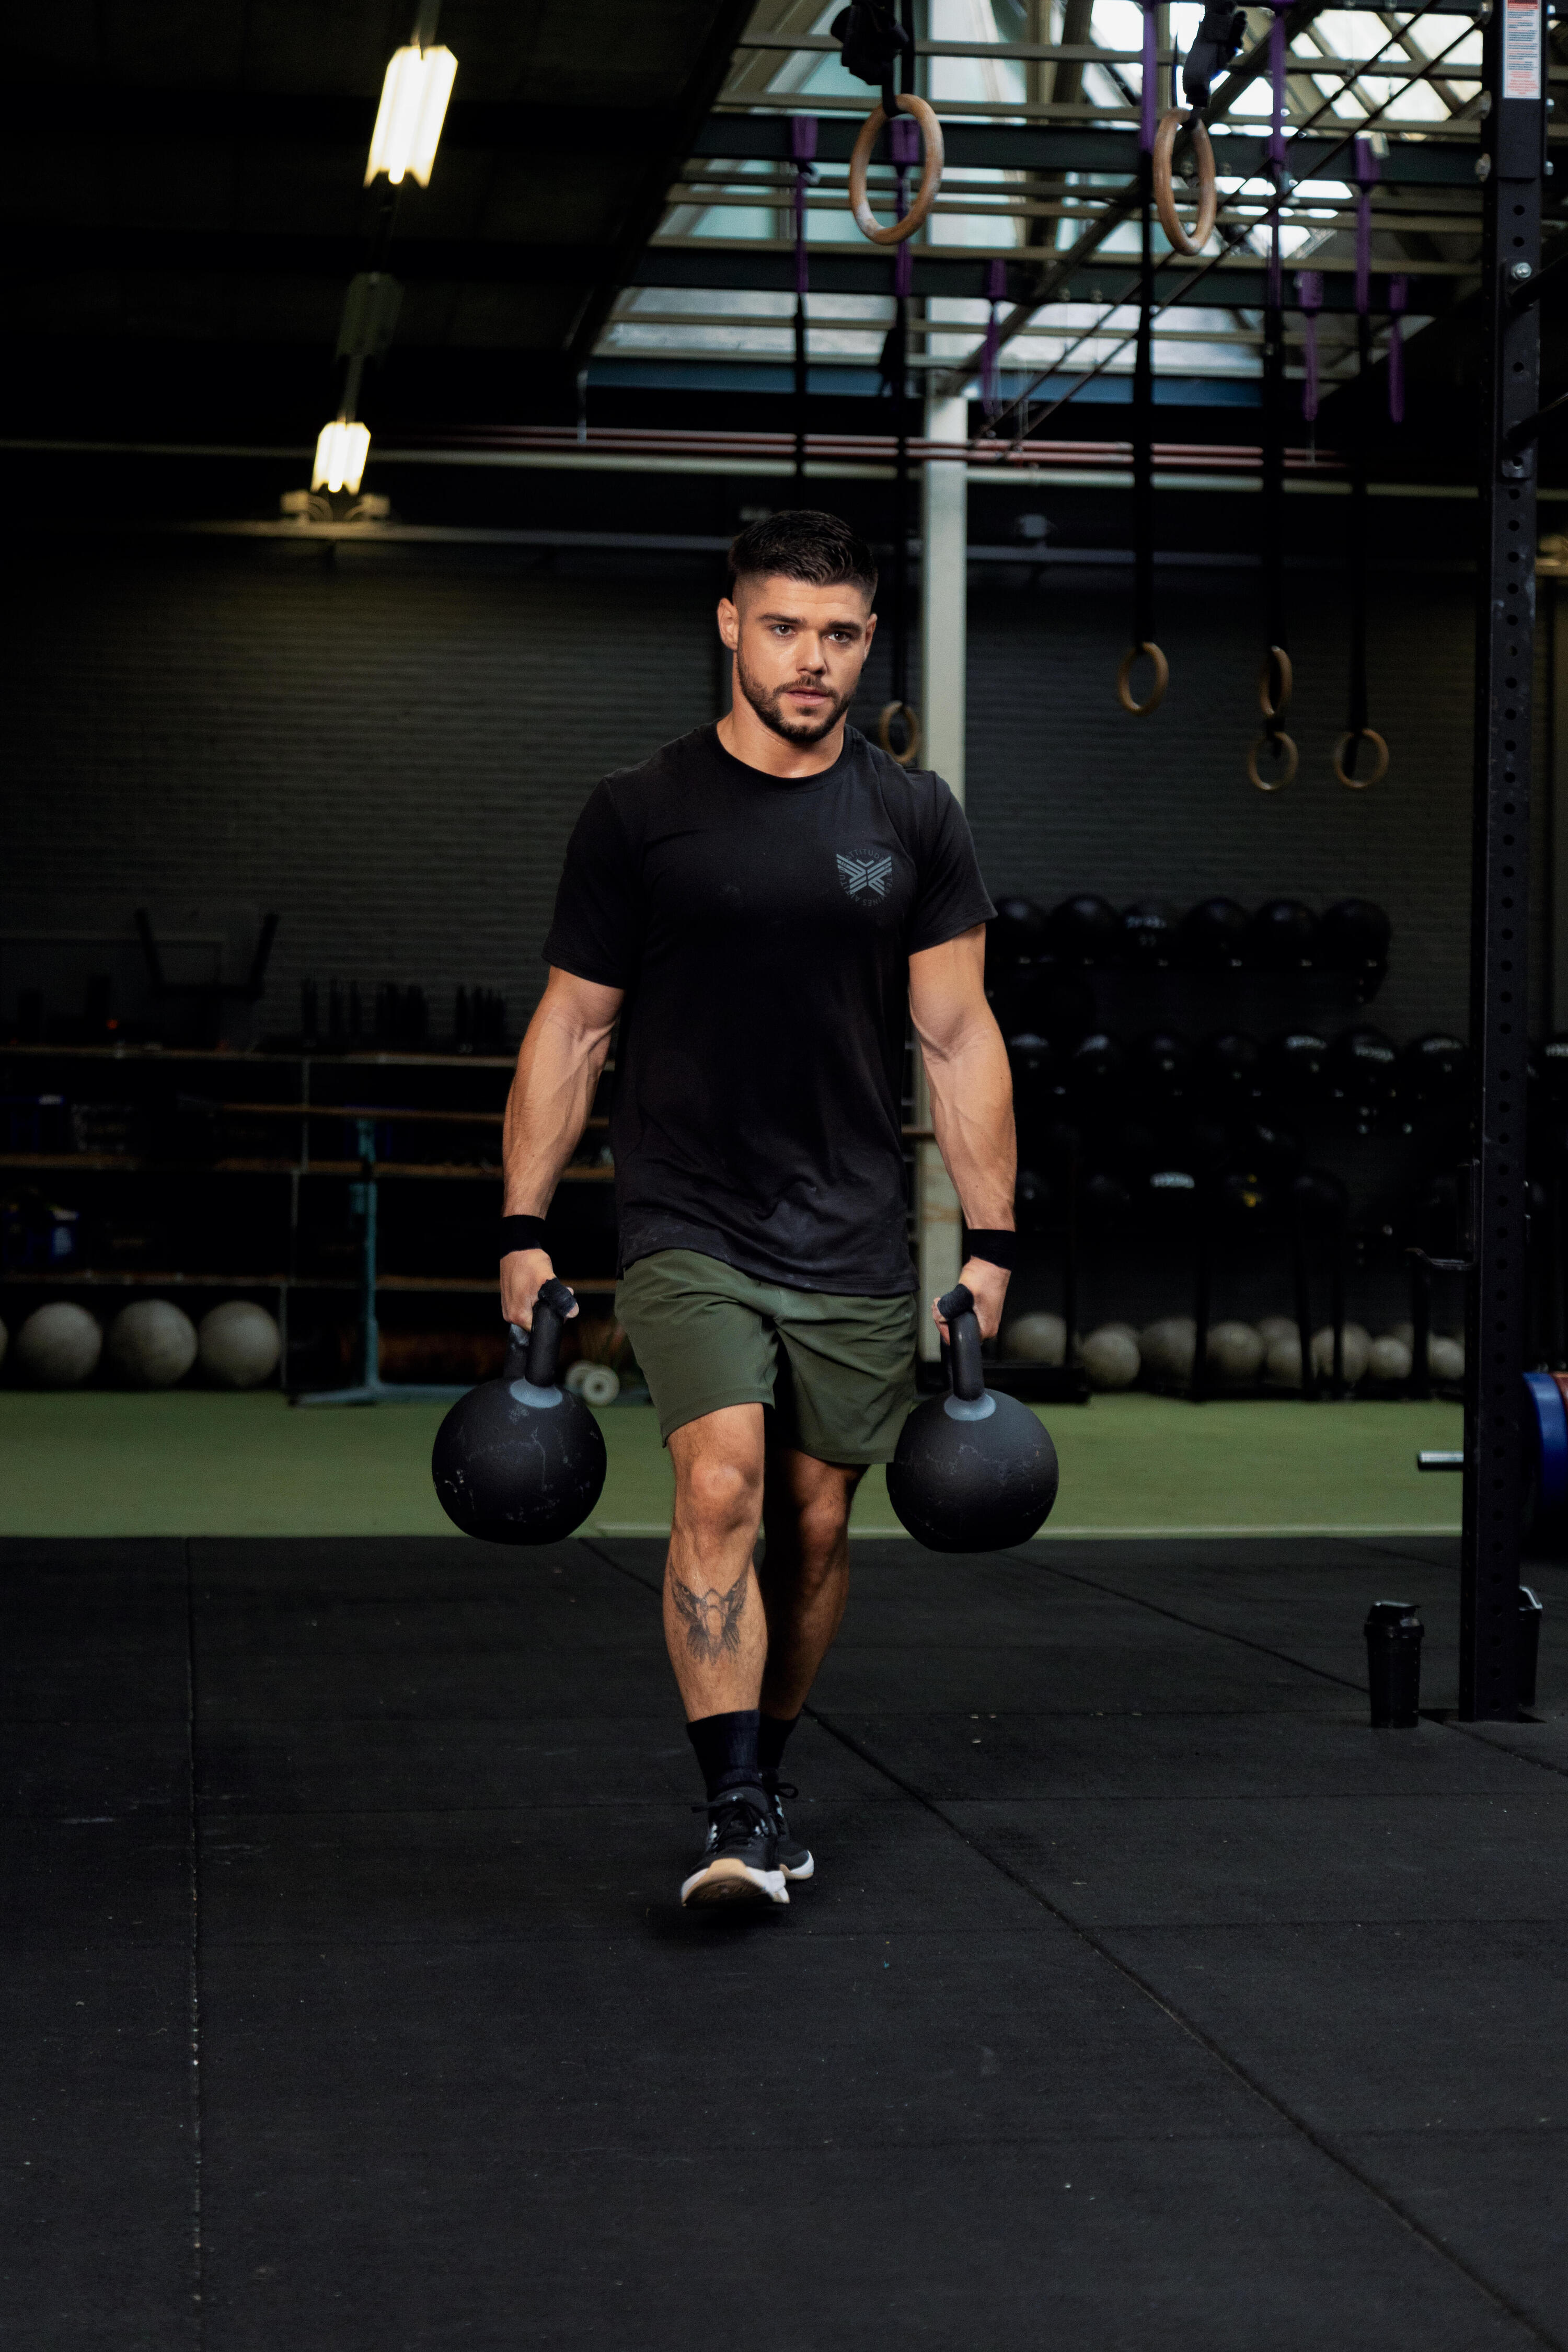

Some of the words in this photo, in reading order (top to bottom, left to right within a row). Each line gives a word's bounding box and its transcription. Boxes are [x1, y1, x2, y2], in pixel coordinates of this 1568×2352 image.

[845, 848, 885, 863] ATTITUDE
[839, 860, 861, 902] ALTITUDE
[862, 863, 893, 907] DETERMINES
